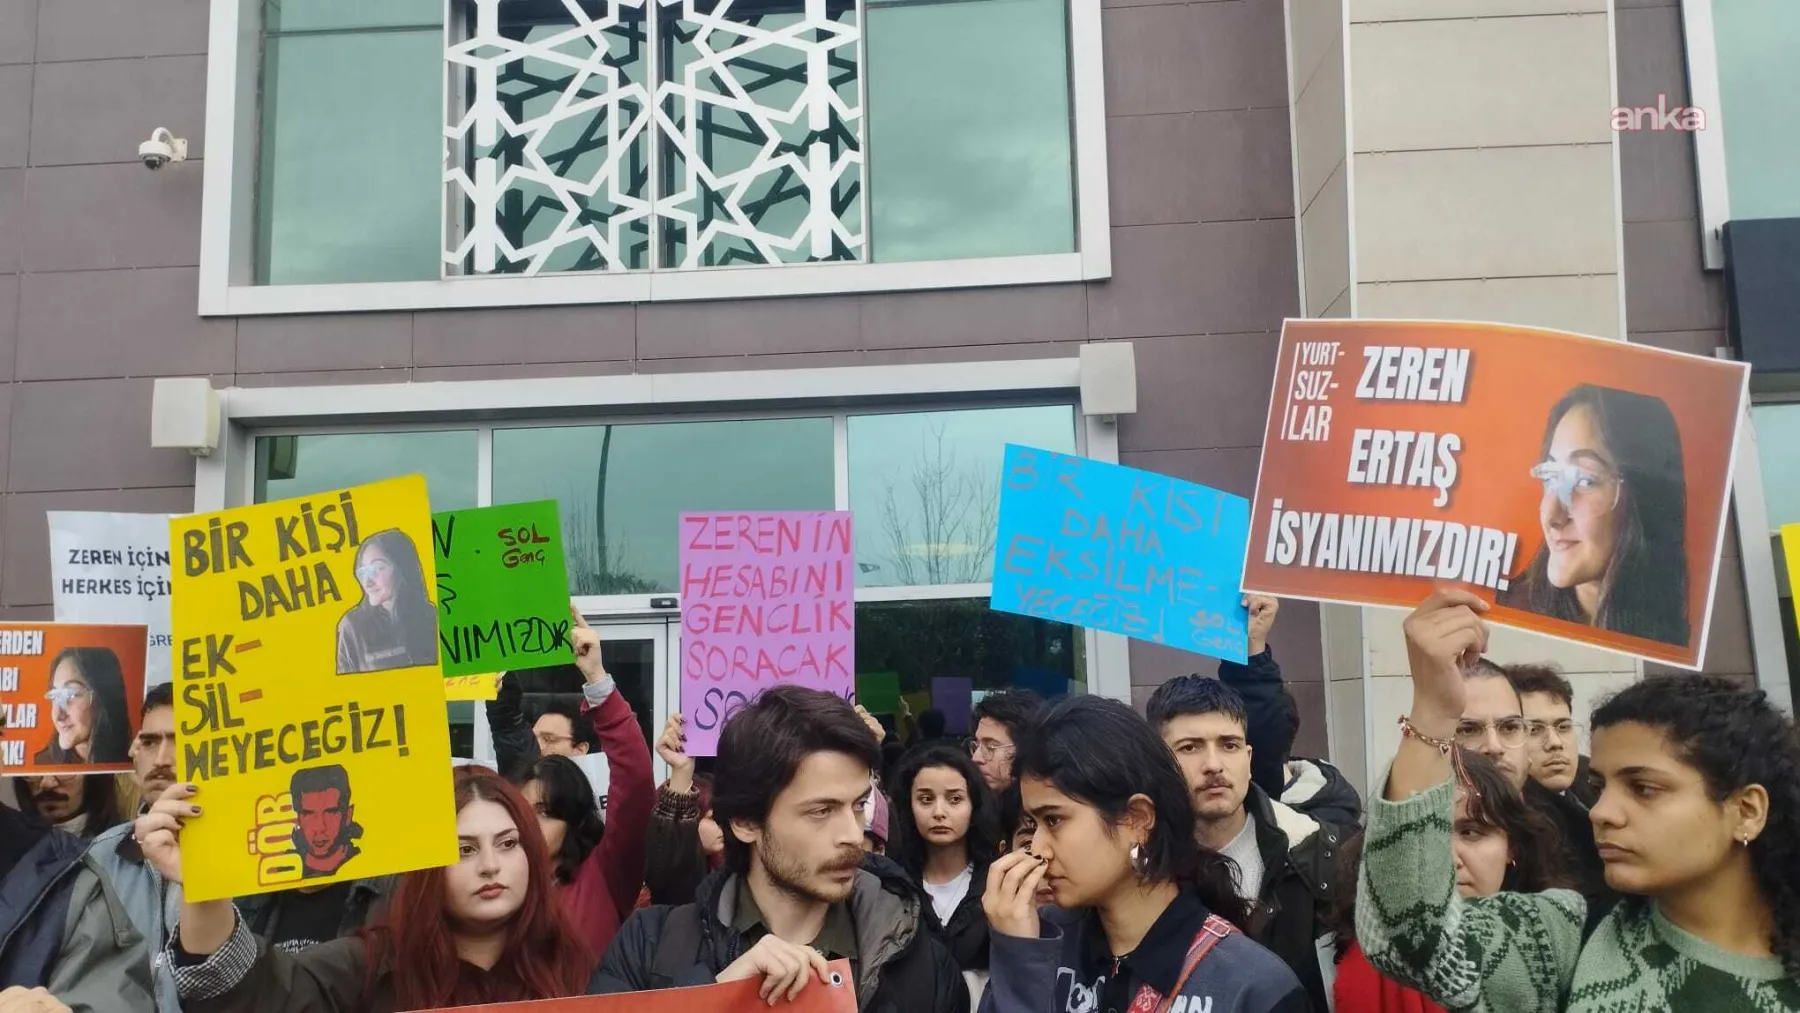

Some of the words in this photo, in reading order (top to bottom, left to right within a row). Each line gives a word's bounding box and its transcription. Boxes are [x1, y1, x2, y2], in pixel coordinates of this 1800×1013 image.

[1301, 341, 1345, 366] YURT-
[1355, 345, 1470, 402] ZEREN
[1294, 371, 1339, 401] SUZ-
[1287, 405, 1333, 441] LAR
[1347, 428, 1461, 508] ERTAŞ
[183, 516, 255, 577] BİR
[274, 490, 361, 564] KİŞİ
[497, 521, 550, 546] SOL
[1060, 507, 1164, 562] DAHA
[1264, 498, 1518, 592] İSYANIMIZDIR!
[68, 549, 122, 565] ZEREN
[62, 578, 132, 595] HERKES
[237, 561, 343, 622] DAHA
[683, 560, 843, 600] HESABINI
[0, 630, 43, 655] RDEN
[182, 634, 262, 680] EK-
[686, 640, 849, 682] SORACAK
[180, 682, 263, 736] SİL-
[184, 701, 410, 782] MEYECEĞİZ!
